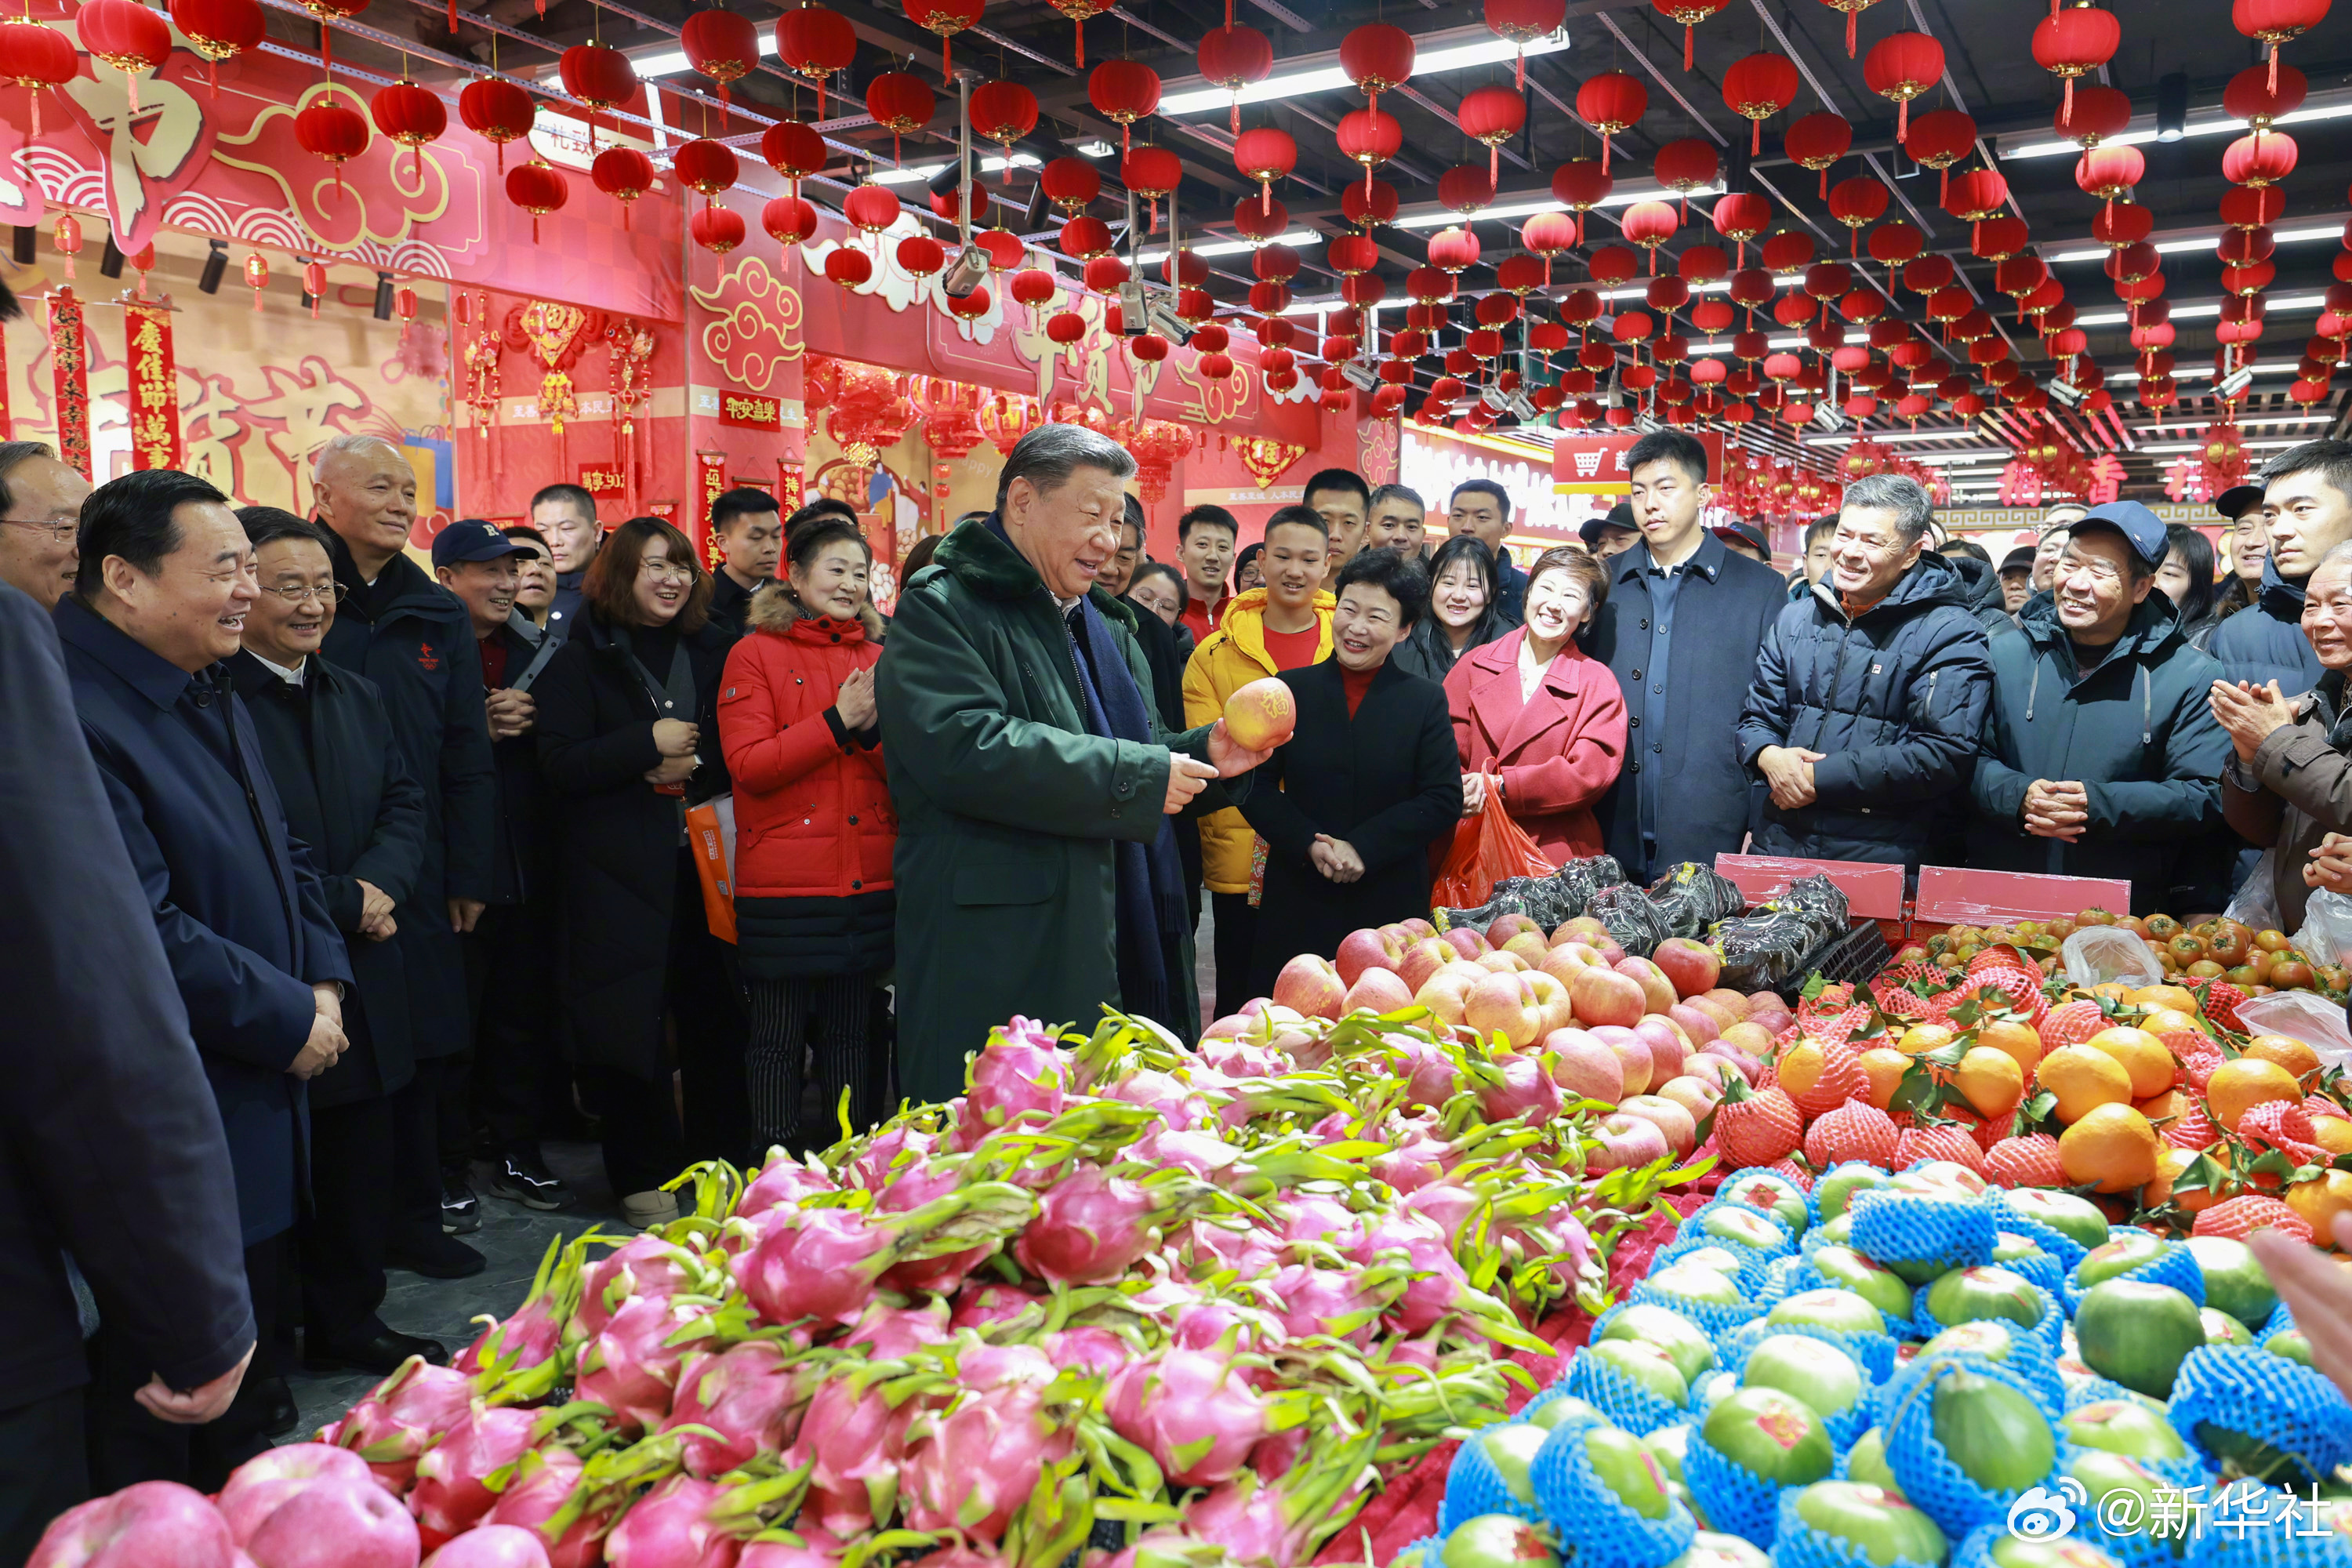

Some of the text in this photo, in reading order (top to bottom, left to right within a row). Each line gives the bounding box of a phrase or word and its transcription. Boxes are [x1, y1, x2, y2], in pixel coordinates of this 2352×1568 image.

[957, 458, 993, 477] appy
[483, 524, 499, 536] R
[1261, 687, 1290, 719] 福
